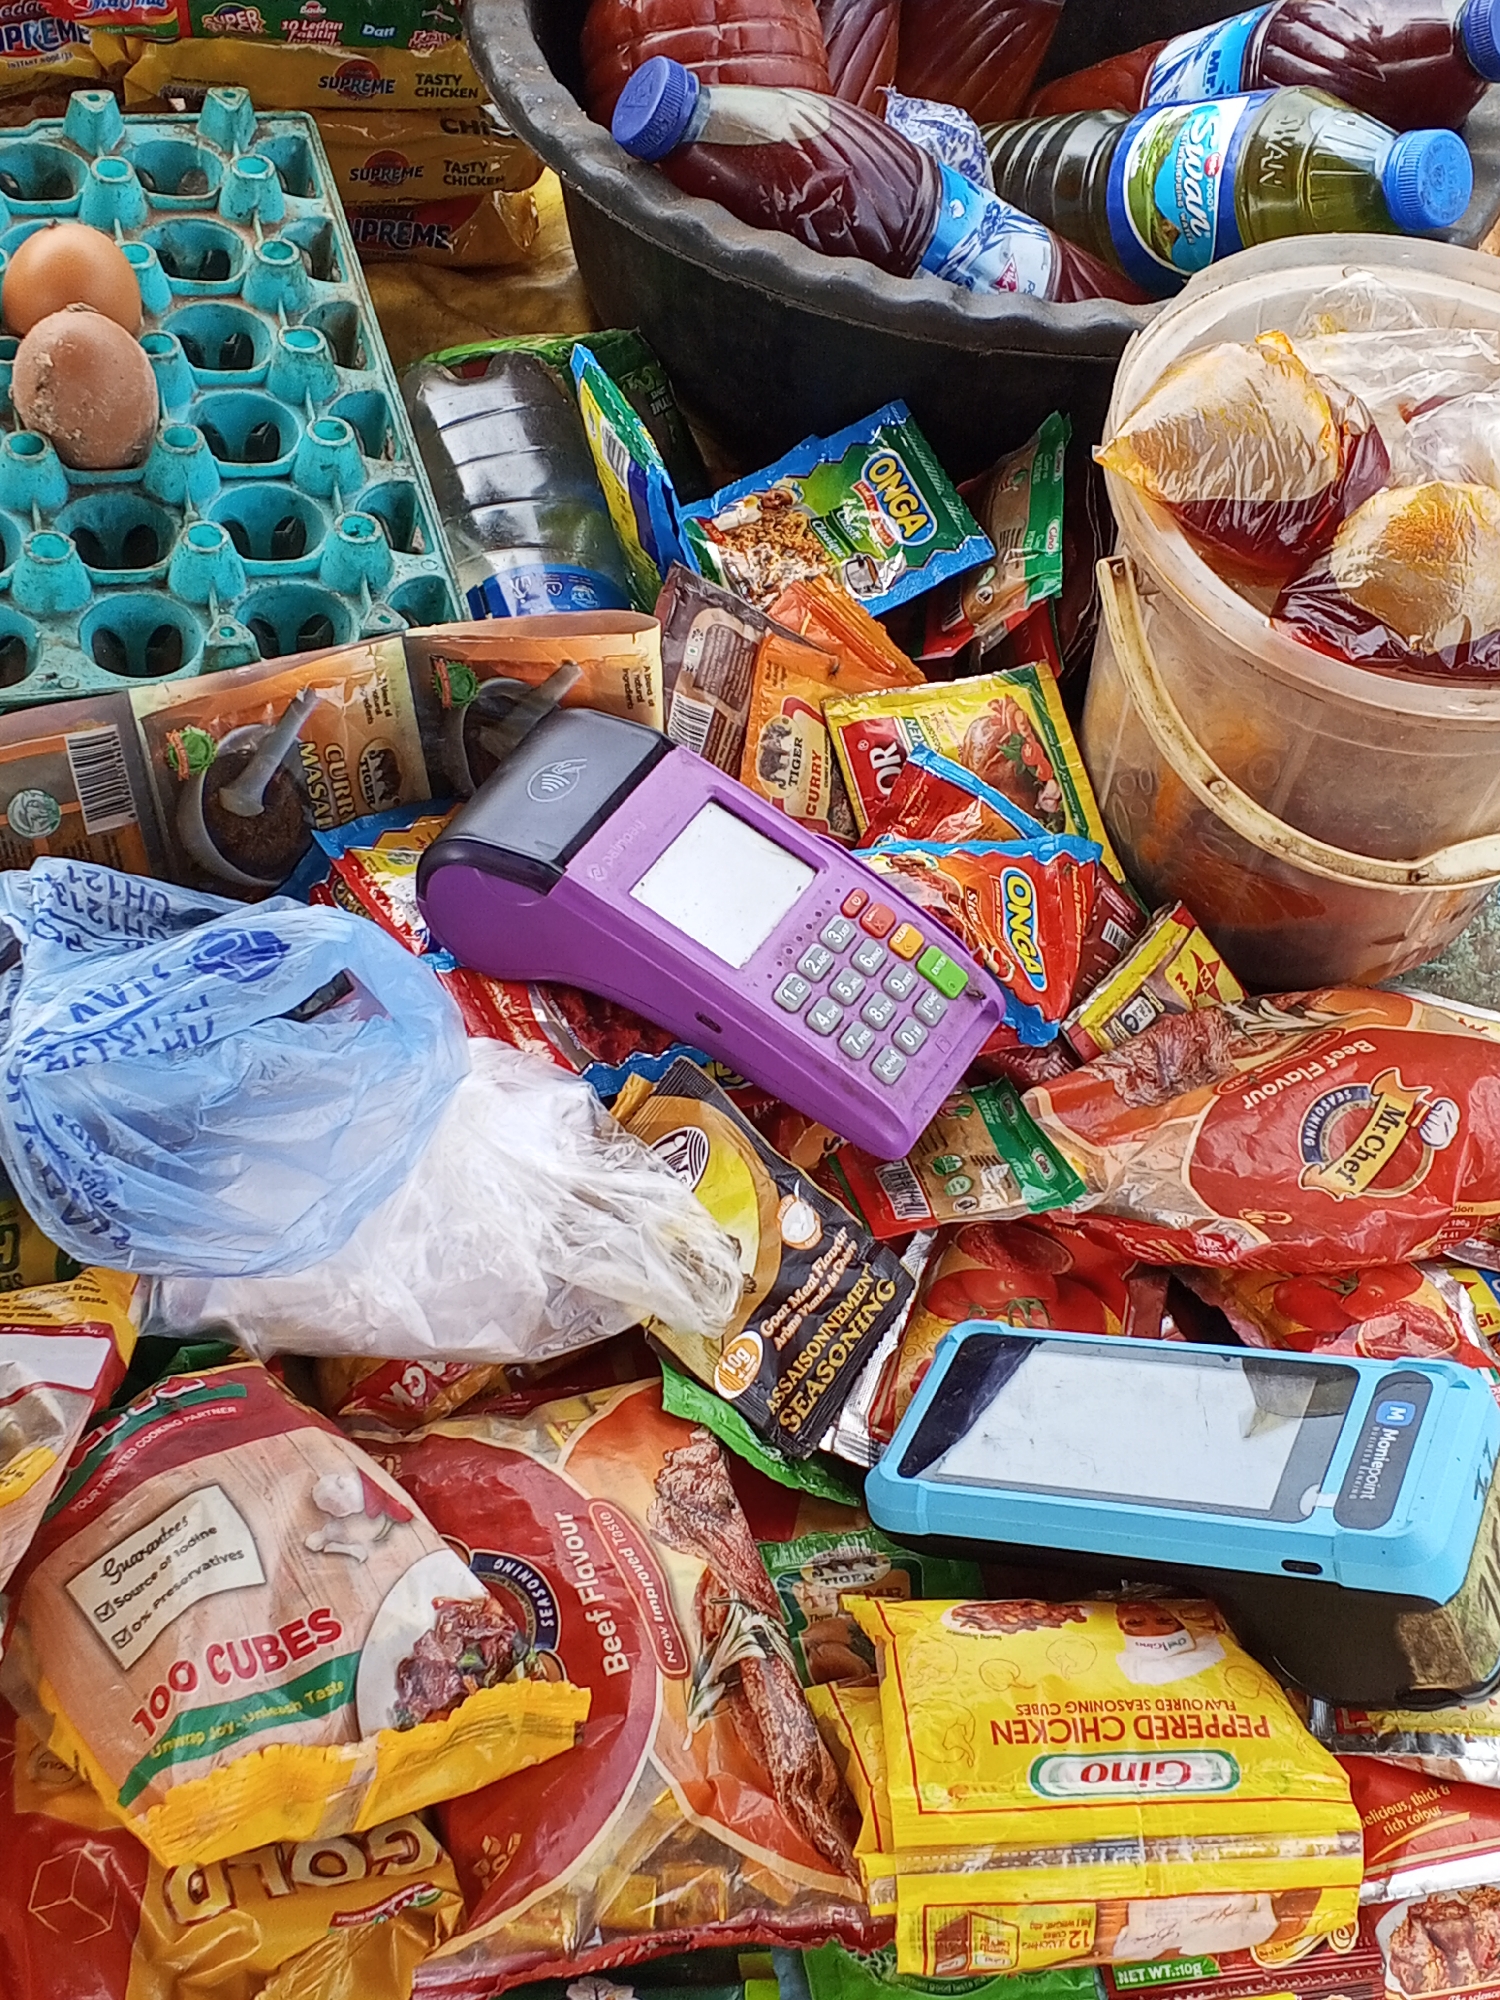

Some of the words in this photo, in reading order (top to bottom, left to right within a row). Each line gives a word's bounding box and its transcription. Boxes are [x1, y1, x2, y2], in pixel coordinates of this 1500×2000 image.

[0, 18, 92, 52] PREME
[203, 10, 259, 28] SUPER
[318, 75, 397, 96] SUPREME
[413, 86, 480, 99] CHICKEN
[414, 73, 463, 86] TASTY
[349, 165, 425, 183] SUPREME
[443, 159, 489, 175] TASTY
[1183, 113, 1218, 238] Swan
[1205, 178, 1214, 213] FOODS
[868, 457, 929, 540] ONGA
[810, 518, 847, 561] Classique
[1048, 524, 1058, 551] Gino
[620, 667, 634, 711] ingredients
[632, 671, 645, 704] natural
[906, 718, 927, 748] KEN
[787, 736, 804, 788] TIGER
[869, 740, 901, 799] OR
[359, 757, 377, 812] TIGER
[805, 749, 824, 817] CURRY
[602, 817, 647, 868] palmpay
[966, 887, 982, 926] Stew
[827, 929, 841, 944] 3
[1005, 876, 1044, 975] ONGA
[805, 959, 820, 975] 2
[817, 952, 831, 968] ABC
[859, 955, 873, 968] 6
[782, 988, 798, 1002] 1
[837, 982, 852, 998] 5
[890, 979, 905, 993] 9
[815, 1011, 829, 1027] 4
[869, 1007, 883, 1022] 8
[880, 1000, 893, 1015] TUV
[845, 1036, 861, 1051] 7
[858, 1029, 871, 1044] PRS
[900, 1032, 916, 1046] 0
[1326, 1038, 1377, 1068] Beef
[1241, 1060, 1327, 1111] Flavour
[1302, 1088, 1353, 1150] SEASONING
[1036, 1153, 1051, 1175] Gino
[78, 1294, 109, 1306] taste
[761, 1303, 792, 1338] Goat
[789, 1272, 820, 1306] Meat
[767, 1263, 876, 1412] ASSAISONNEMENT
[726, 1344, 751, 1374] 10g
[778, 1279, 897, 1434] SEASONING
[1386, 1404, 1408, 1422] M
[70, 1485, 103, 1514] YOUR
[99, 1446, 139, 1491] TRUSTED
[135, 1418, 183, 1448] COOKING
[183, 1405, 237, 1423] PARTNER
[1360, 1426, 1381, 1464] BUSINESS
[1359, 1427, 1400, 1503] Moniepoint
[600, 1511, 628, 1546] Taste
[100, 1514, 190, 1586] Guarantees
[554, 1510, 607, 1607] Flavour
[113, 1568, 160, 1610] Source
[157, 1553, 174, 1574] of
[131, 1608, 154, 1634] 0%
[152, 1549, 245, 1612] Preservatives
[492, 1557, 556, 1629] SEASONING
[619, 1546, 666, 1623] Improved
[820, 1570, 877, 1586] TIGER
[585, 1608, 631, 1677] Beef
[1164, 1636, 1188, 1651] Chef
[132, 1658, 200, 1739] 100
[205, 1606, 344, 1686] CUBES
[150, 1728, 205, 1760] Unwrap
[242, 1700, 304, 1729] Unleash
[304, 1679, 346, 1706] Taste
[1016, 1701, 1061, 1717] CUBES
[1065, 1699, 1150, 1714] SEASONING
[1155, 1698, 1237, 1713] FLAVOURED
[991, 1714, 1127, 1746] CHICKEN
[1133, 1713, 1271, 1741] PEPPERED
[1080, 1761, 1193, 1788] Gino
[1410, 1785, 1441, 1812] thick
[1382, 1816, 1406, 1838] rich
[1405, 1804, 1444, 1831] colour
[1068, 1929, 1091, 1949] 12
[1117, 1966, 1146, 1985] NET
